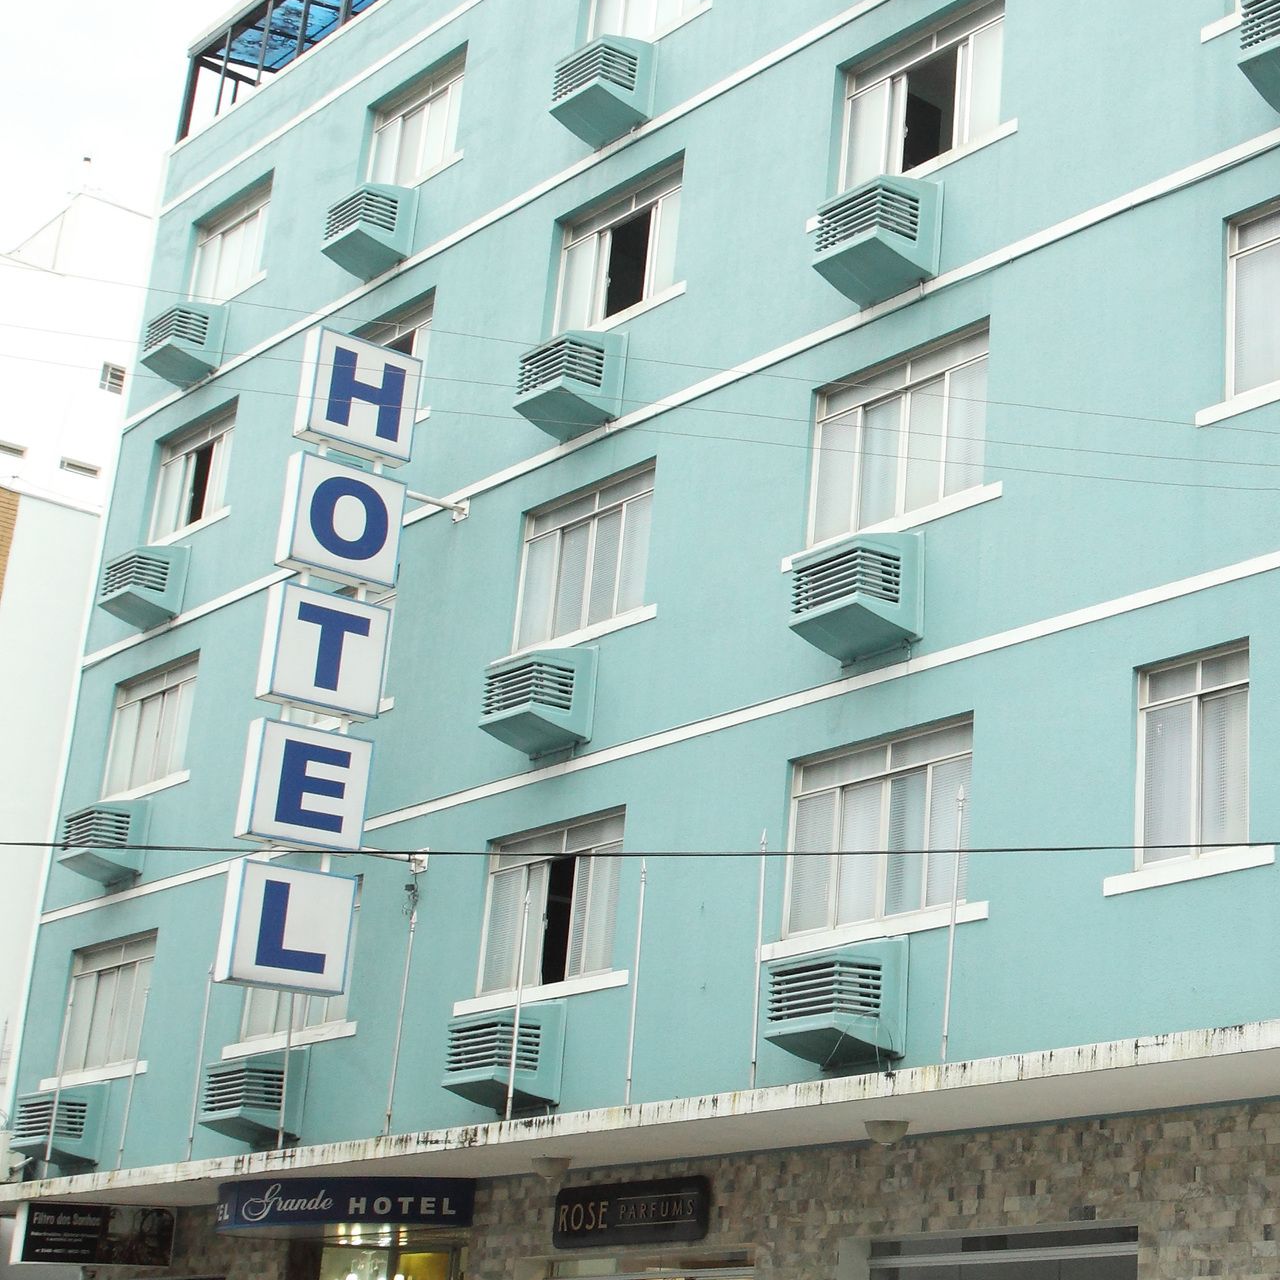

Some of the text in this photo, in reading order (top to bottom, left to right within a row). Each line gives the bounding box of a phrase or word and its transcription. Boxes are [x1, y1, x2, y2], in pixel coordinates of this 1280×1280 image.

[254, 346, 408, 975] HOTEL
[242, 1183, 334, 1221] Grande
[348, 1196, 456, 1216] HOTEL
[558, 1199, 696, 1232] ROSE PARFUMS
